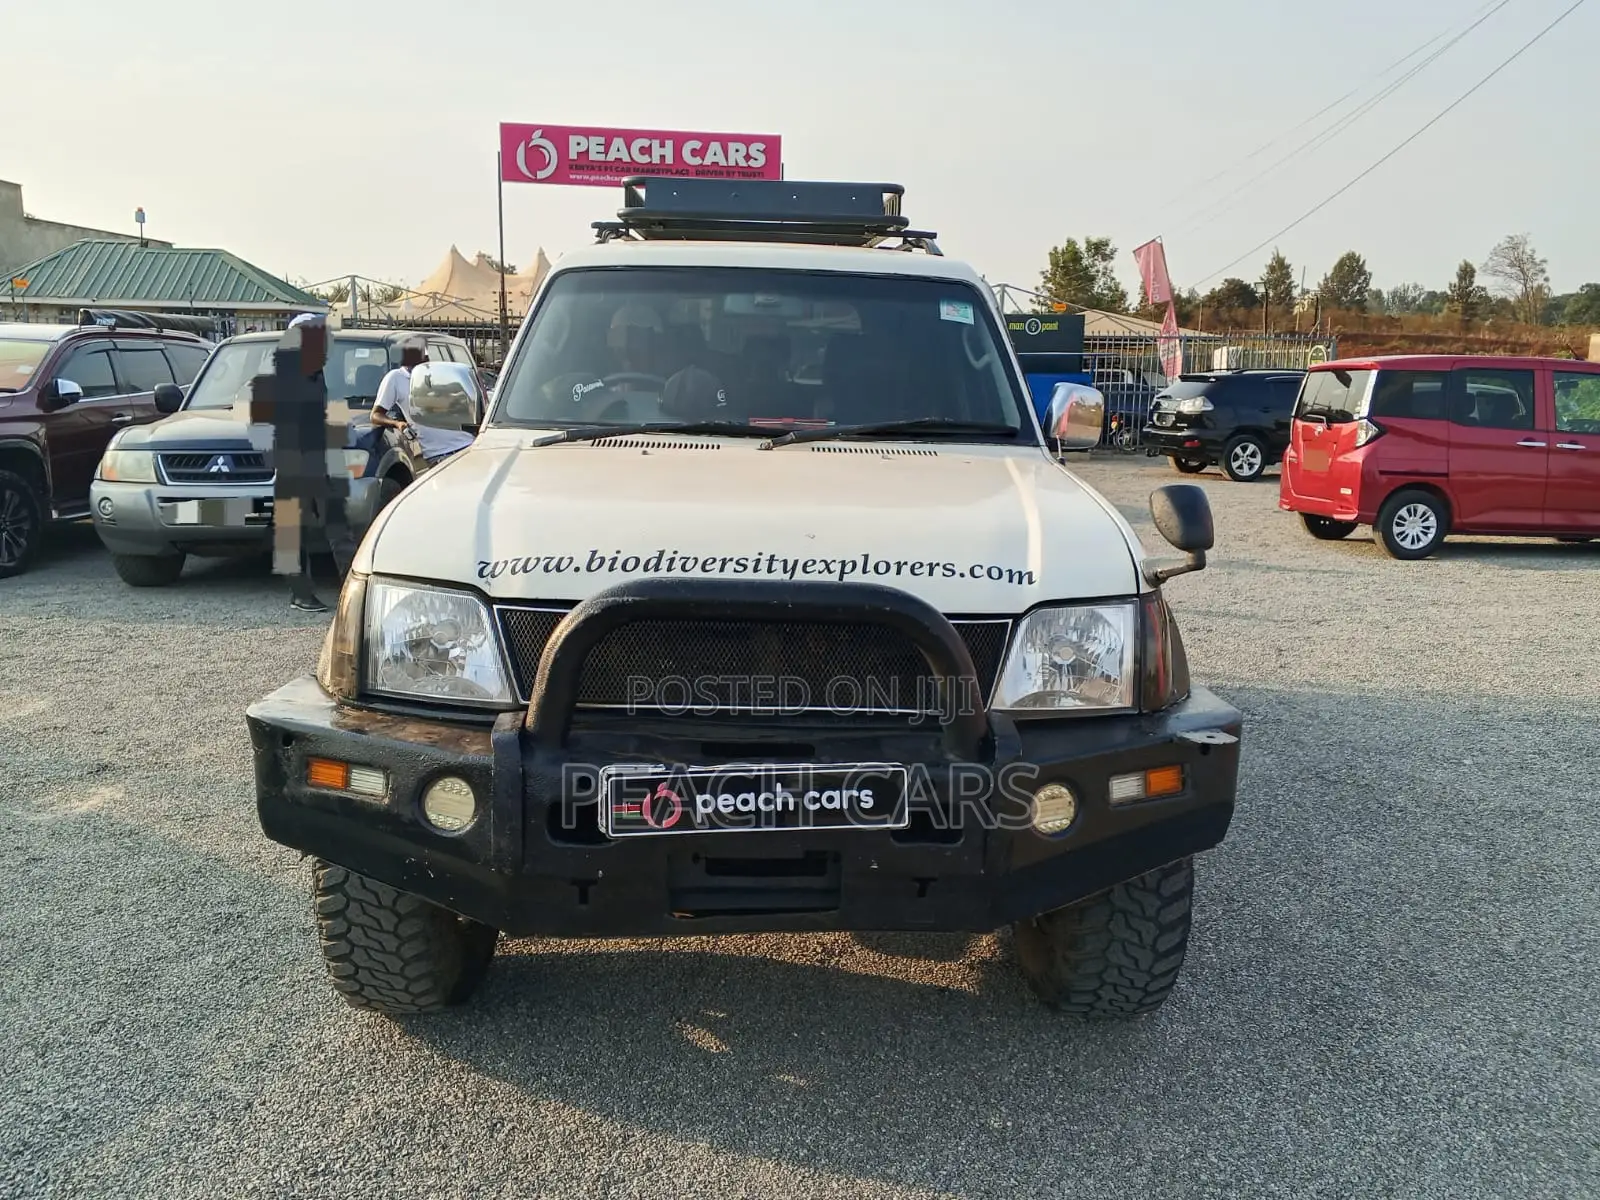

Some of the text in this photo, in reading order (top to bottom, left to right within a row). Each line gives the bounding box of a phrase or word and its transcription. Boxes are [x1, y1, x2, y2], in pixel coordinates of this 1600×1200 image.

[568, 134, 767, 168] PEACH CARS
[695, 169, 725, 177] DRIVEN
[477, 549, 1037, 586] www.biodiversityexplorers.com
[695, 782, 875, 823] peach cars
